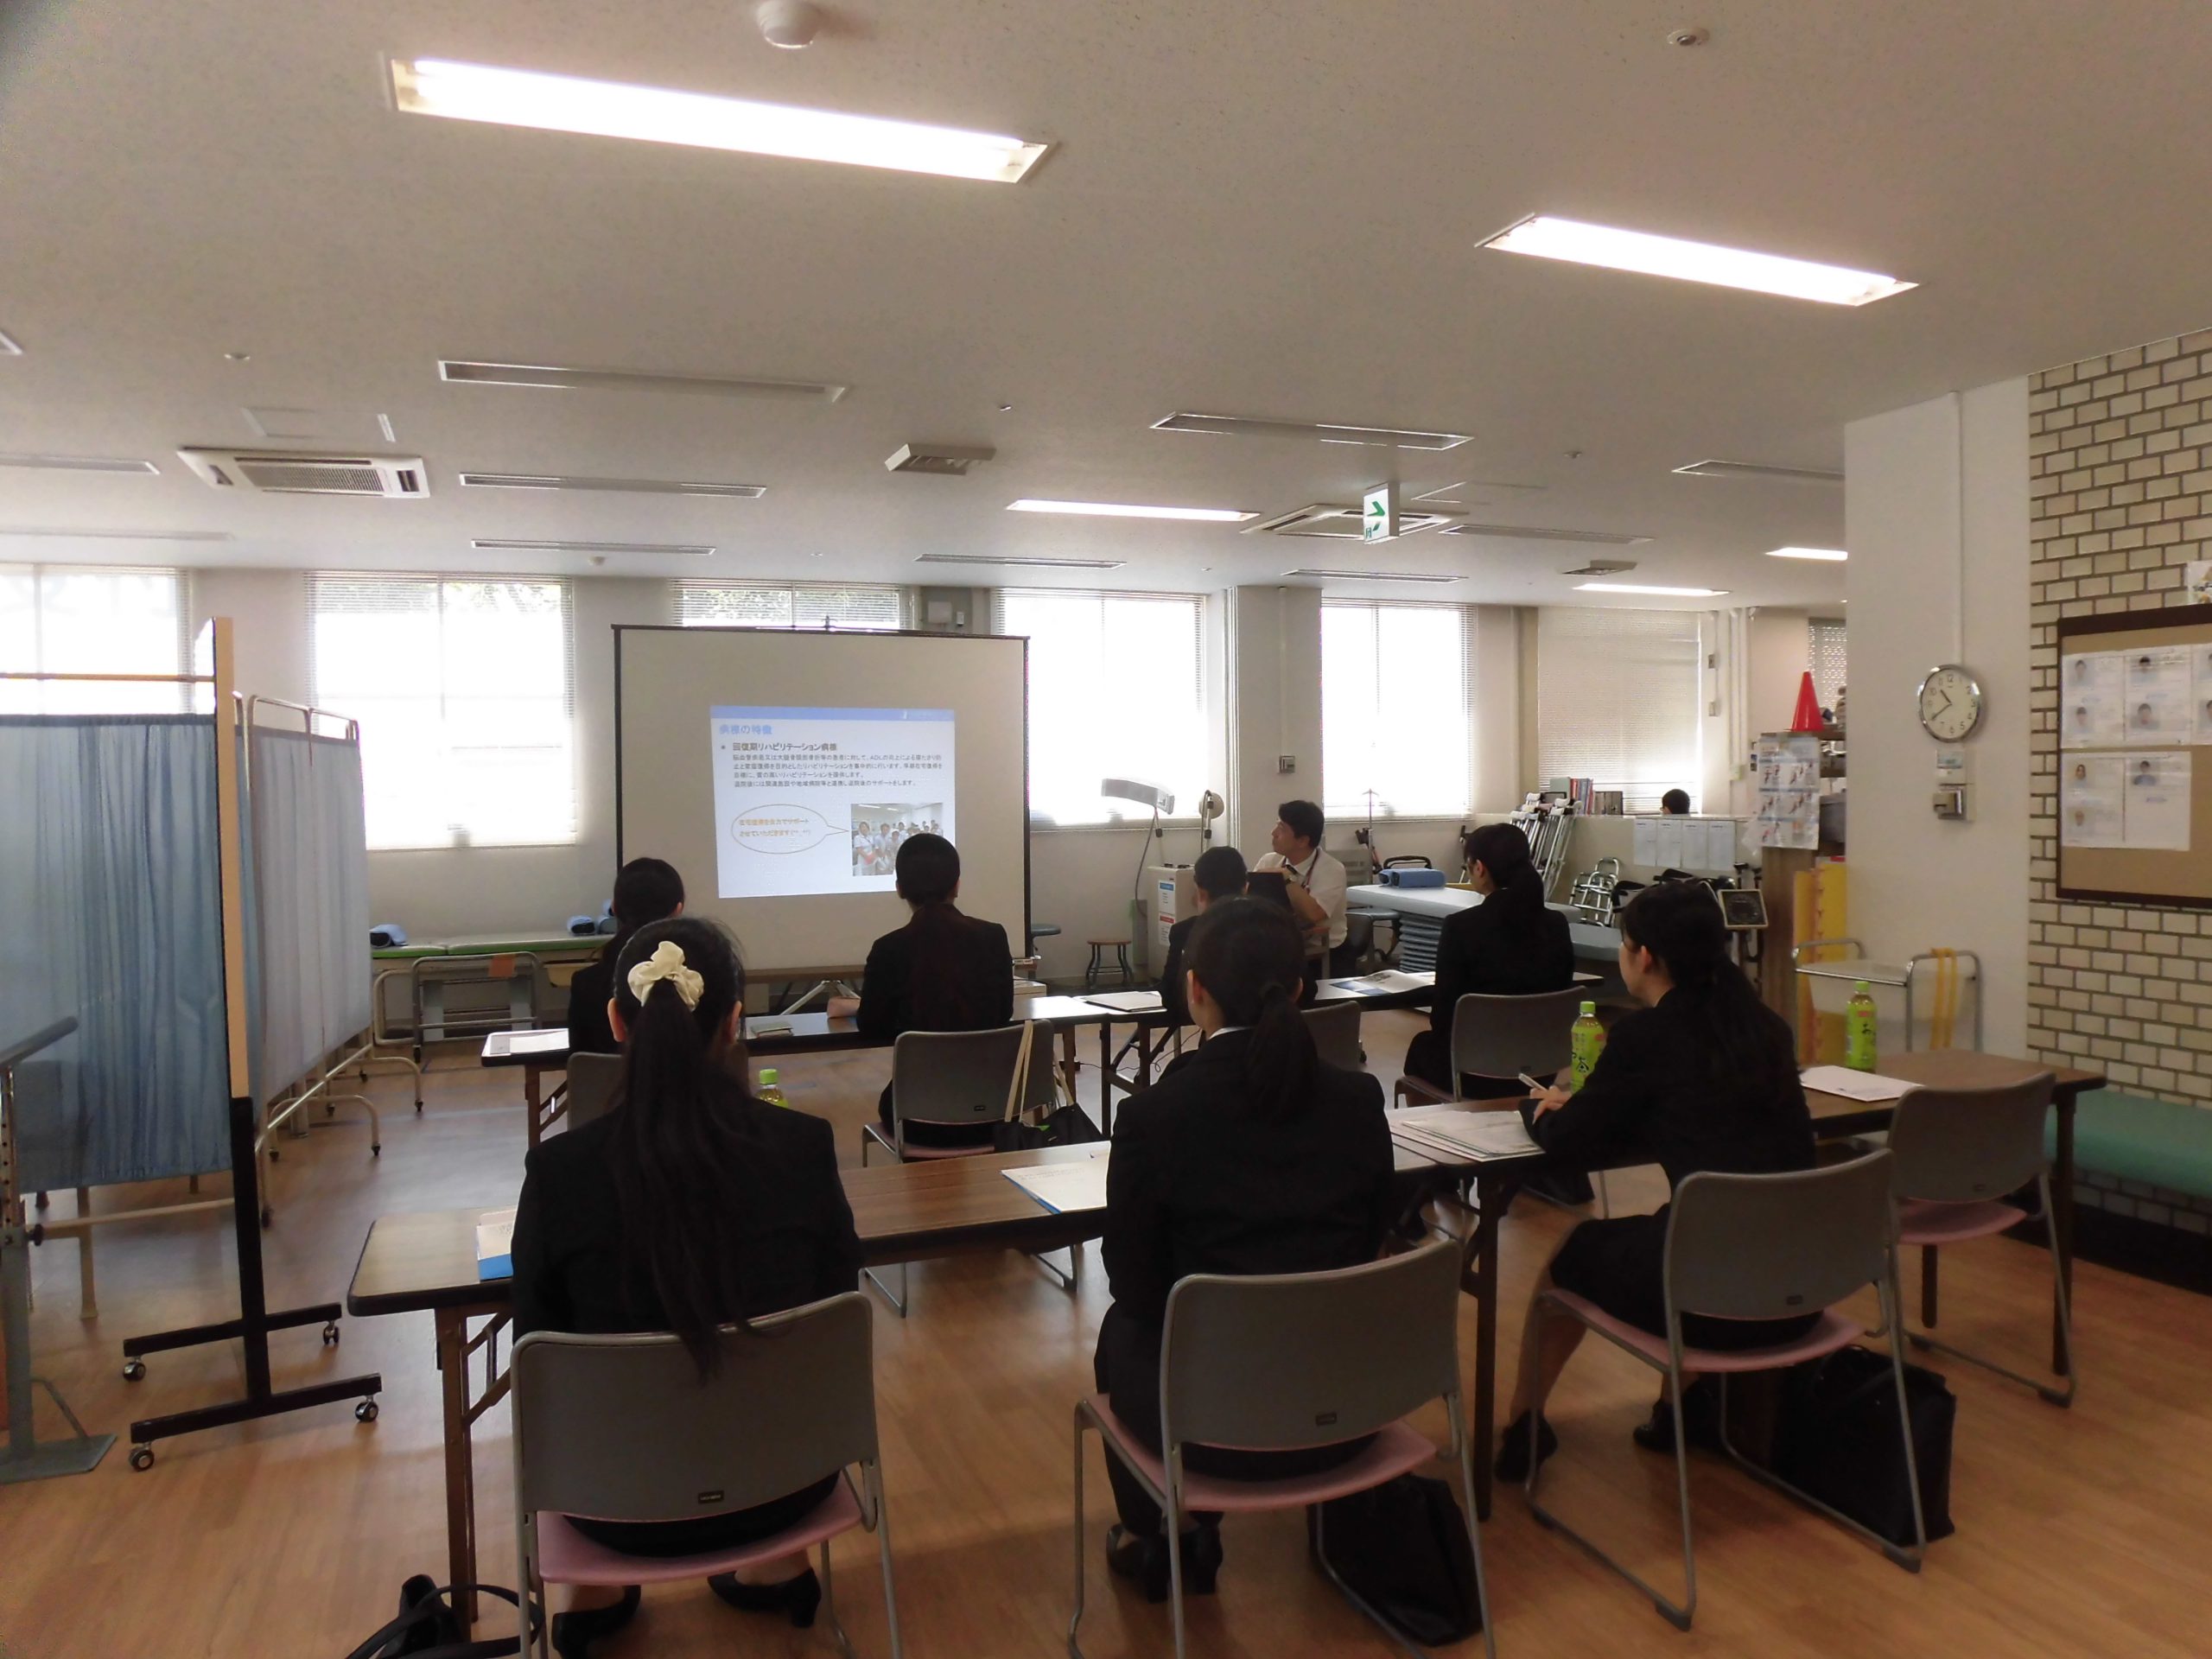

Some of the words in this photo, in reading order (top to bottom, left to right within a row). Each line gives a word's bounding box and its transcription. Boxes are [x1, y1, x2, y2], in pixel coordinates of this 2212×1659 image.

[733, 742, 837, 752] 回復期リハビリテーション病棟
